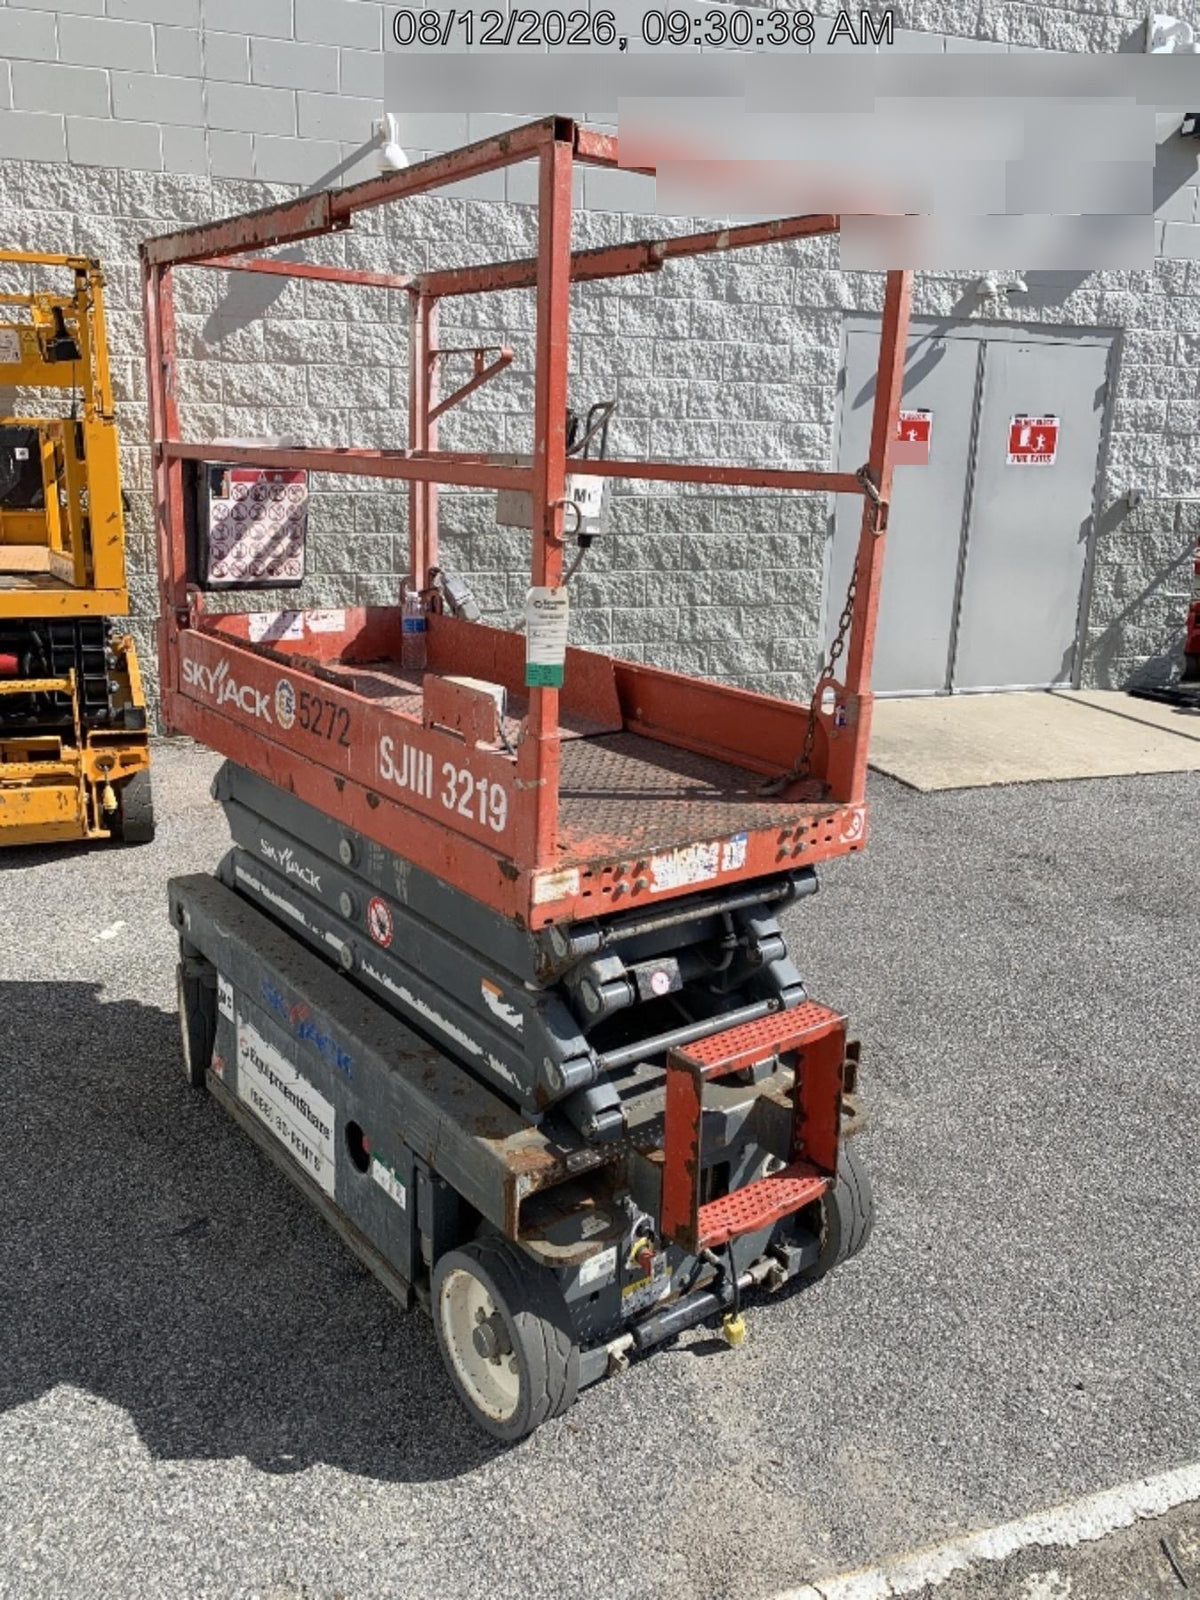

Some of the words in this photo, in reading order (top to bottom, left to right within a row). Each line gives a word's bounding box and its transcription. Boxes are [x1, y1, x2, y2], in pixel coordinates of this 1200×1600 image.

[182, 657, 273, 724] SKYJACK
[299, 690, 351, 746] 5272
[379, 735, 433, 799] SJIII
[441, 762, 507, 832] 3219
[260, 838, 323, 893] SKYJACK
